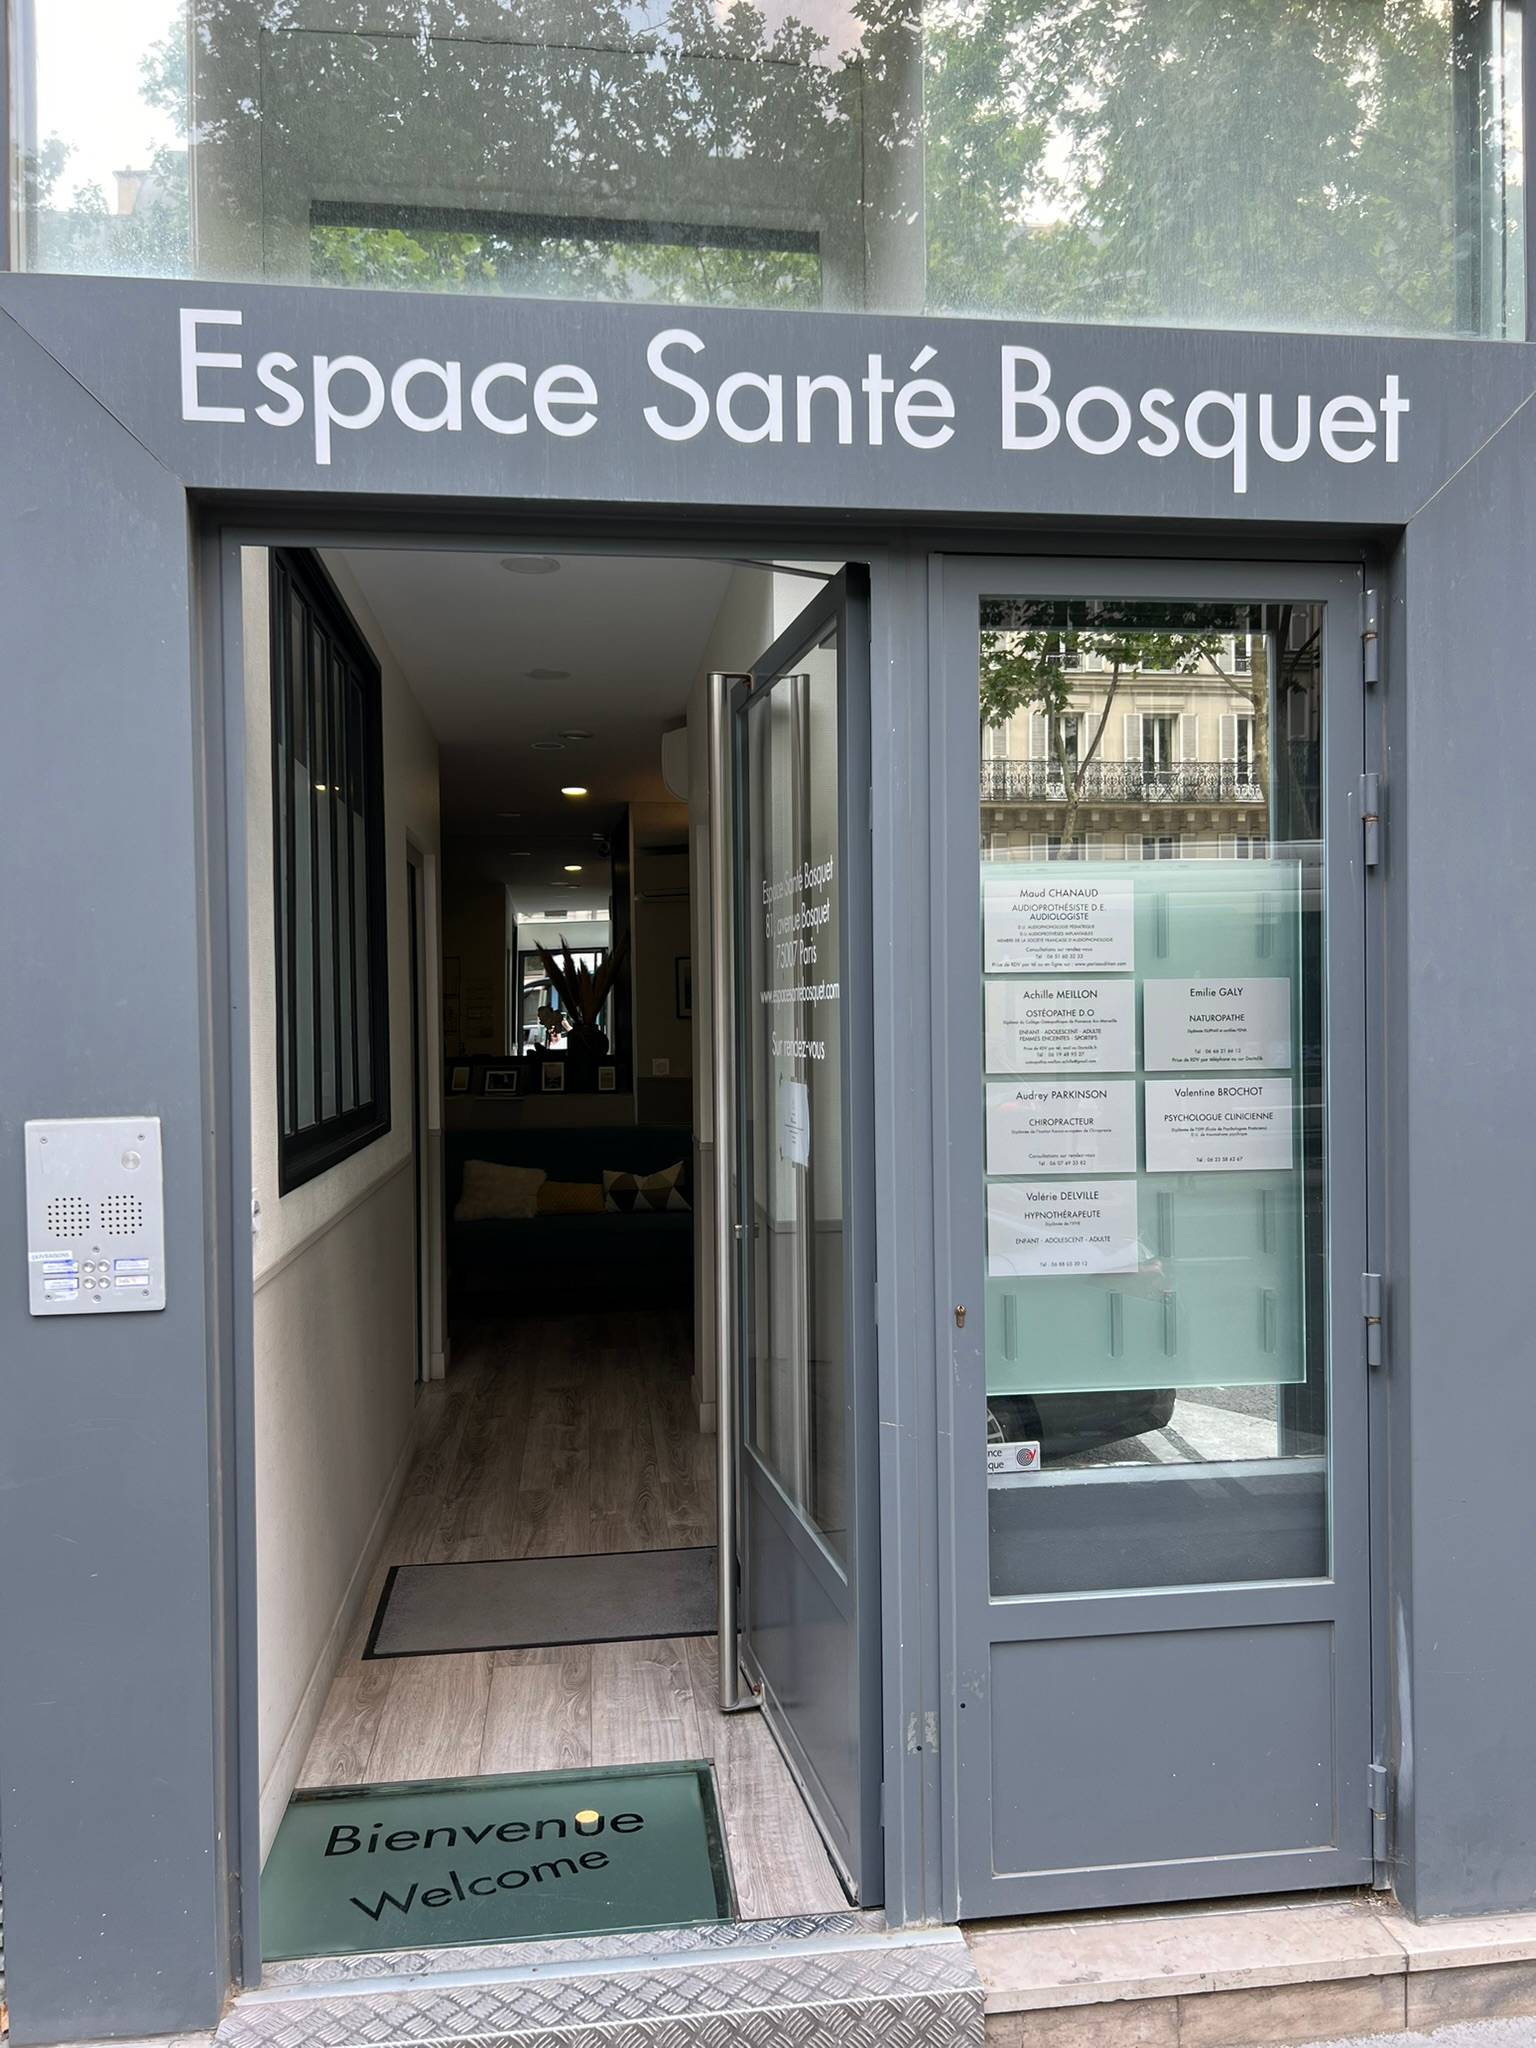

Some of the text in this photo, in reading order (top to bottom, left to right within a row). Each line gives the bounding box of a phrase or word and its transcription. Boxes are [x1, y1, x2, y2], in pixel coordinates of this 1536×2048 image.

[179, 308, 1410, 494] Espace Santé Bosquet
[762, 879, 784, 912] Espace
[804, 854, 833, 893] Bosquet
[1019, 888, 1099, 898] Maud CHANAUD
[1011, 903, 1089, 912] AUDIOPROTHÉSISTE
[777, 912, 800, 935] avenue
[801, 896, 830, 934] Bosquet
[1030, 912, 1089, 921] AUDIOLOGISTE
[776, 936, 817, 969] 75007 Paris
[1023, 989, 1098, 999] Achille MEILLON
[1189, 987, 1244, 997] Emilie GALY
[1025, 1008, 1076, 1018] OSTÉOPATHE
[1189, 1013, 1246, 1022] NATUROPATHE
[771, 1027, 825, 1060] Sur rendez-vous
[1015, 1089, 1107, 1102] Audrey PARKINSON
[1174, 1087, 1263, 1097] Valentine BROCHOT
[1029, 1117, 1094, 1126] CHIROPRACTEUR
[1164, 1112, 1274, 1122] PSYCHOLOGUE CLINICIENNE
[1026, 1191, 1099, 1201] Valérie DELVILLE
[1024, 1210, 1101, 1220] HYPNOTHÉRAPEUTE
[1044, 1236, 1084, 1244] ADOLESCENT
[323, 1810, 645, 1857] Bienvenue
[349, 1850, 610, 1922] Welcome
